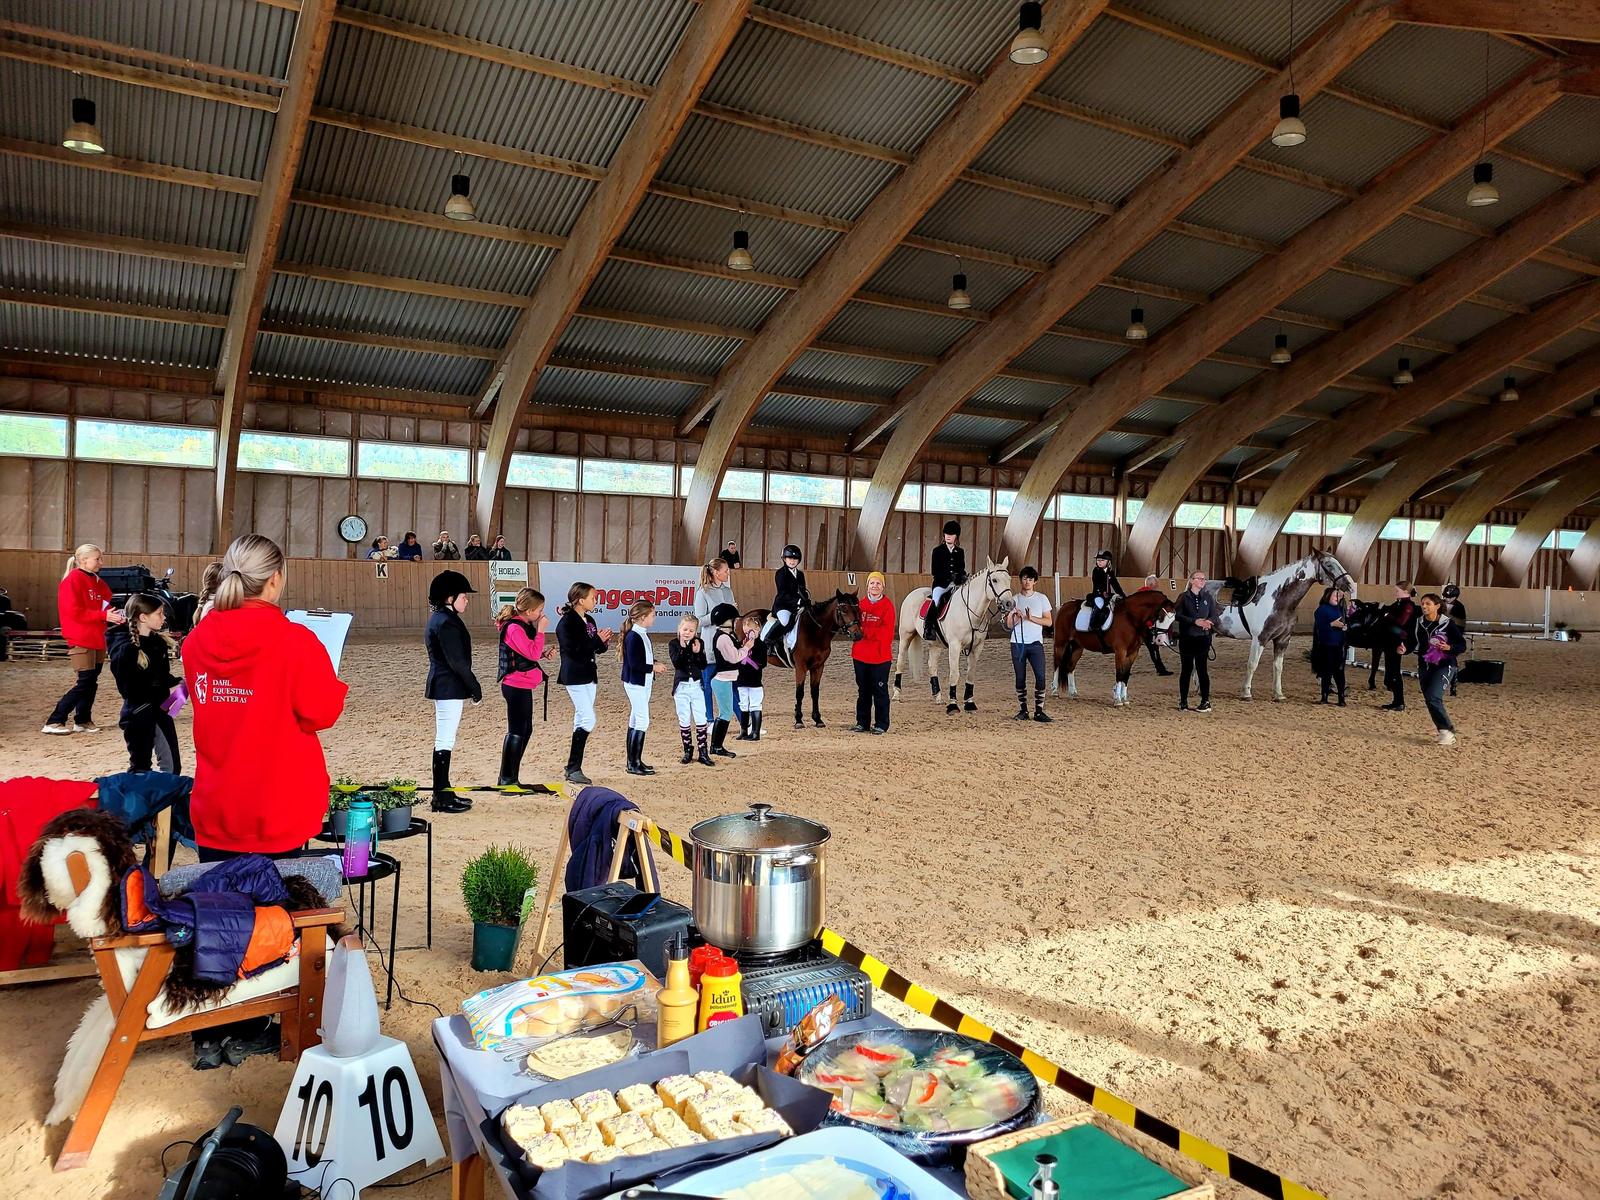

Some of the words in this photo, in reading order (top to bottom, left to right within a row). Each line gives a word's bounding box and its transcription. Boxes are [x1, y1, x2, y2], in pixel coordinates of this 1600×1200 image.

[377, 563, 387, 577] K
[498, 567, 521, 575] HOELS
[655, 578, 696, 586] engerspall.no
[848, 573, 855, 584] V
[1170, 580, 1176, 590] E
[593, 586, 695, 610] ngersPall
[212, 679, 232, 687] DAHL
[212, 687, 254, 696] EQUESTRIAN
[212, 695, 239, 703] CENTER
[711, 993, 736, 1005] Idun
[358, 1065, 414, 1162] 10
[292, 1074, 333, 1168] 10
